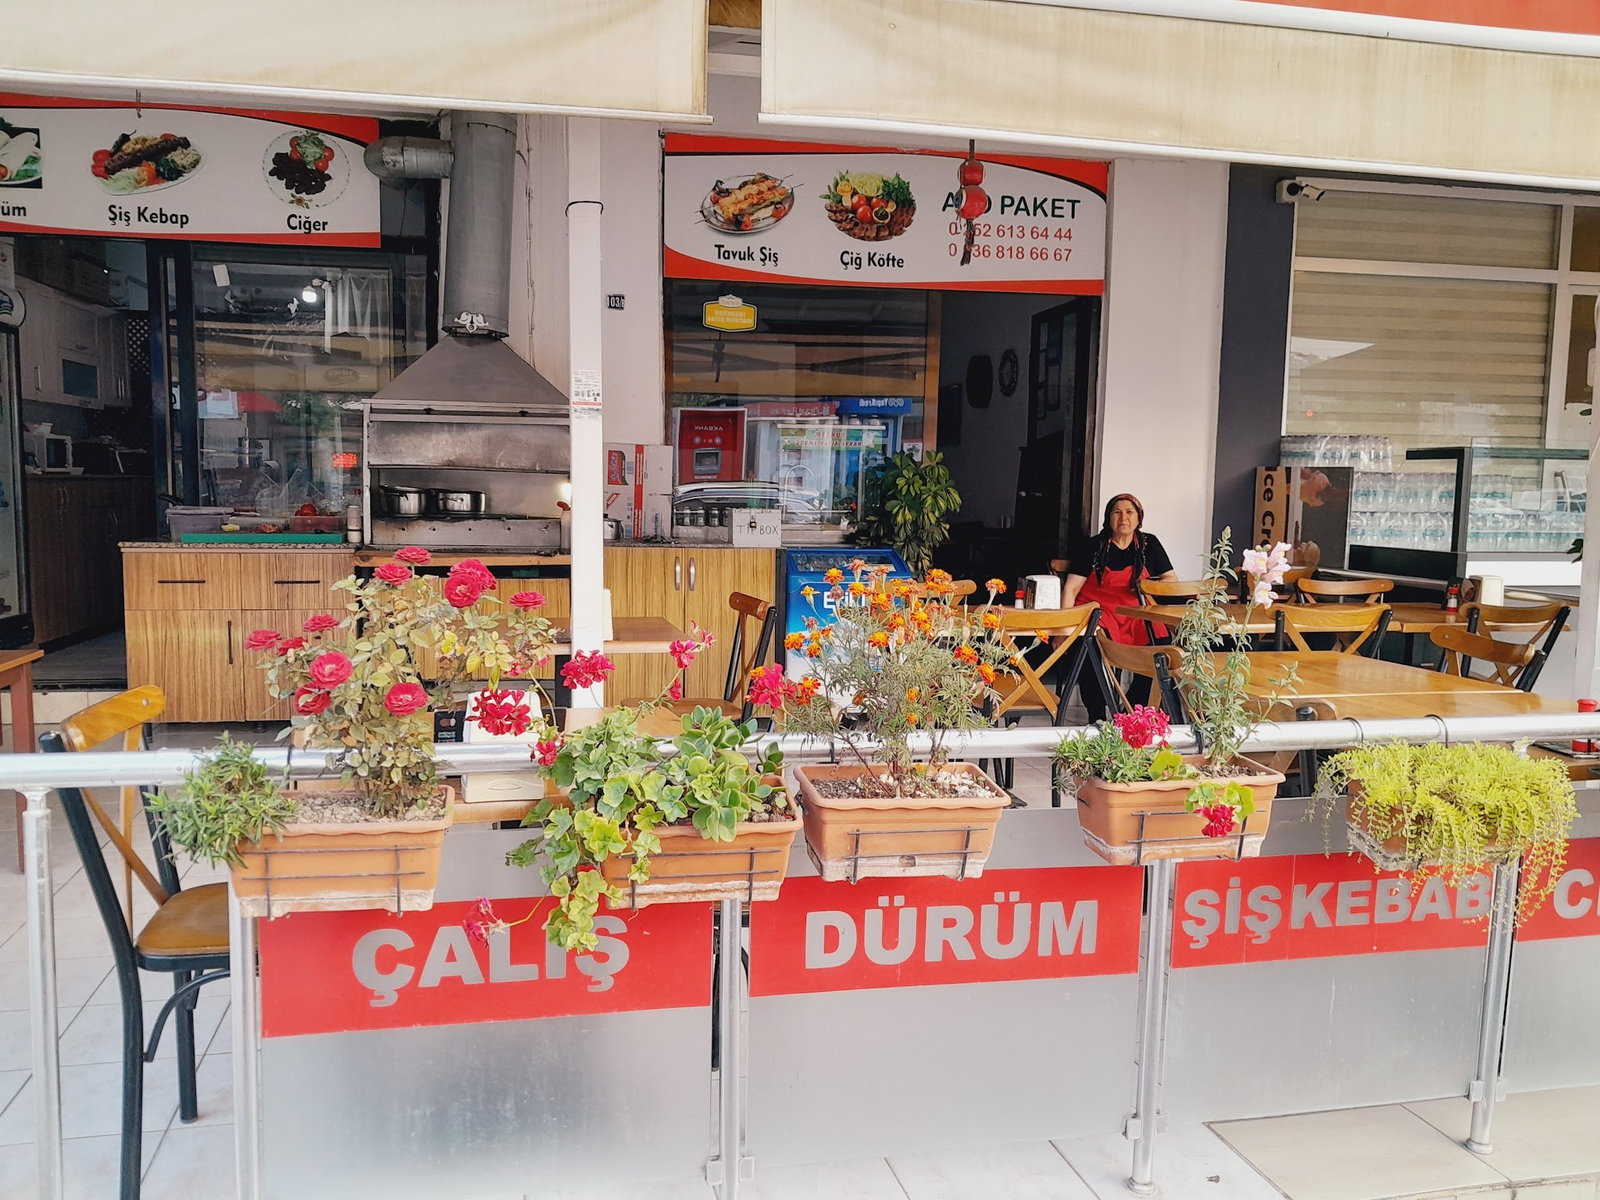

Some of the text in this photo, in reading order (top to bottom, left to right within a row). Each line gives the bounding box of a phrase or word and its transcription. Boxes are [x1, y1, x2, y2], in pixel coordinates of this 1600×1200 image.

[108, 204, 190, 229] Şiş Kebap
[1000, 194, 1082, 219] PAKET
[286, 213, 328, 235] Ciğer
[996, 224, 1026, 240] 613
[1030, 226, 1049, 240] 64
[1053, 227, 1073, 242] 44
[714, 244, 779, 267] Tavuk Şiş
[839, 250, 905, 270] Çiğ Köfte
[995, 245, 1025, 260] 818
[1029, 247, 1049, 261] 66
[1053, 248, 1072, 262] 67
[759, 525, 779, 536] BOX
[804, 891, 1099, 970] DÜRÜM
